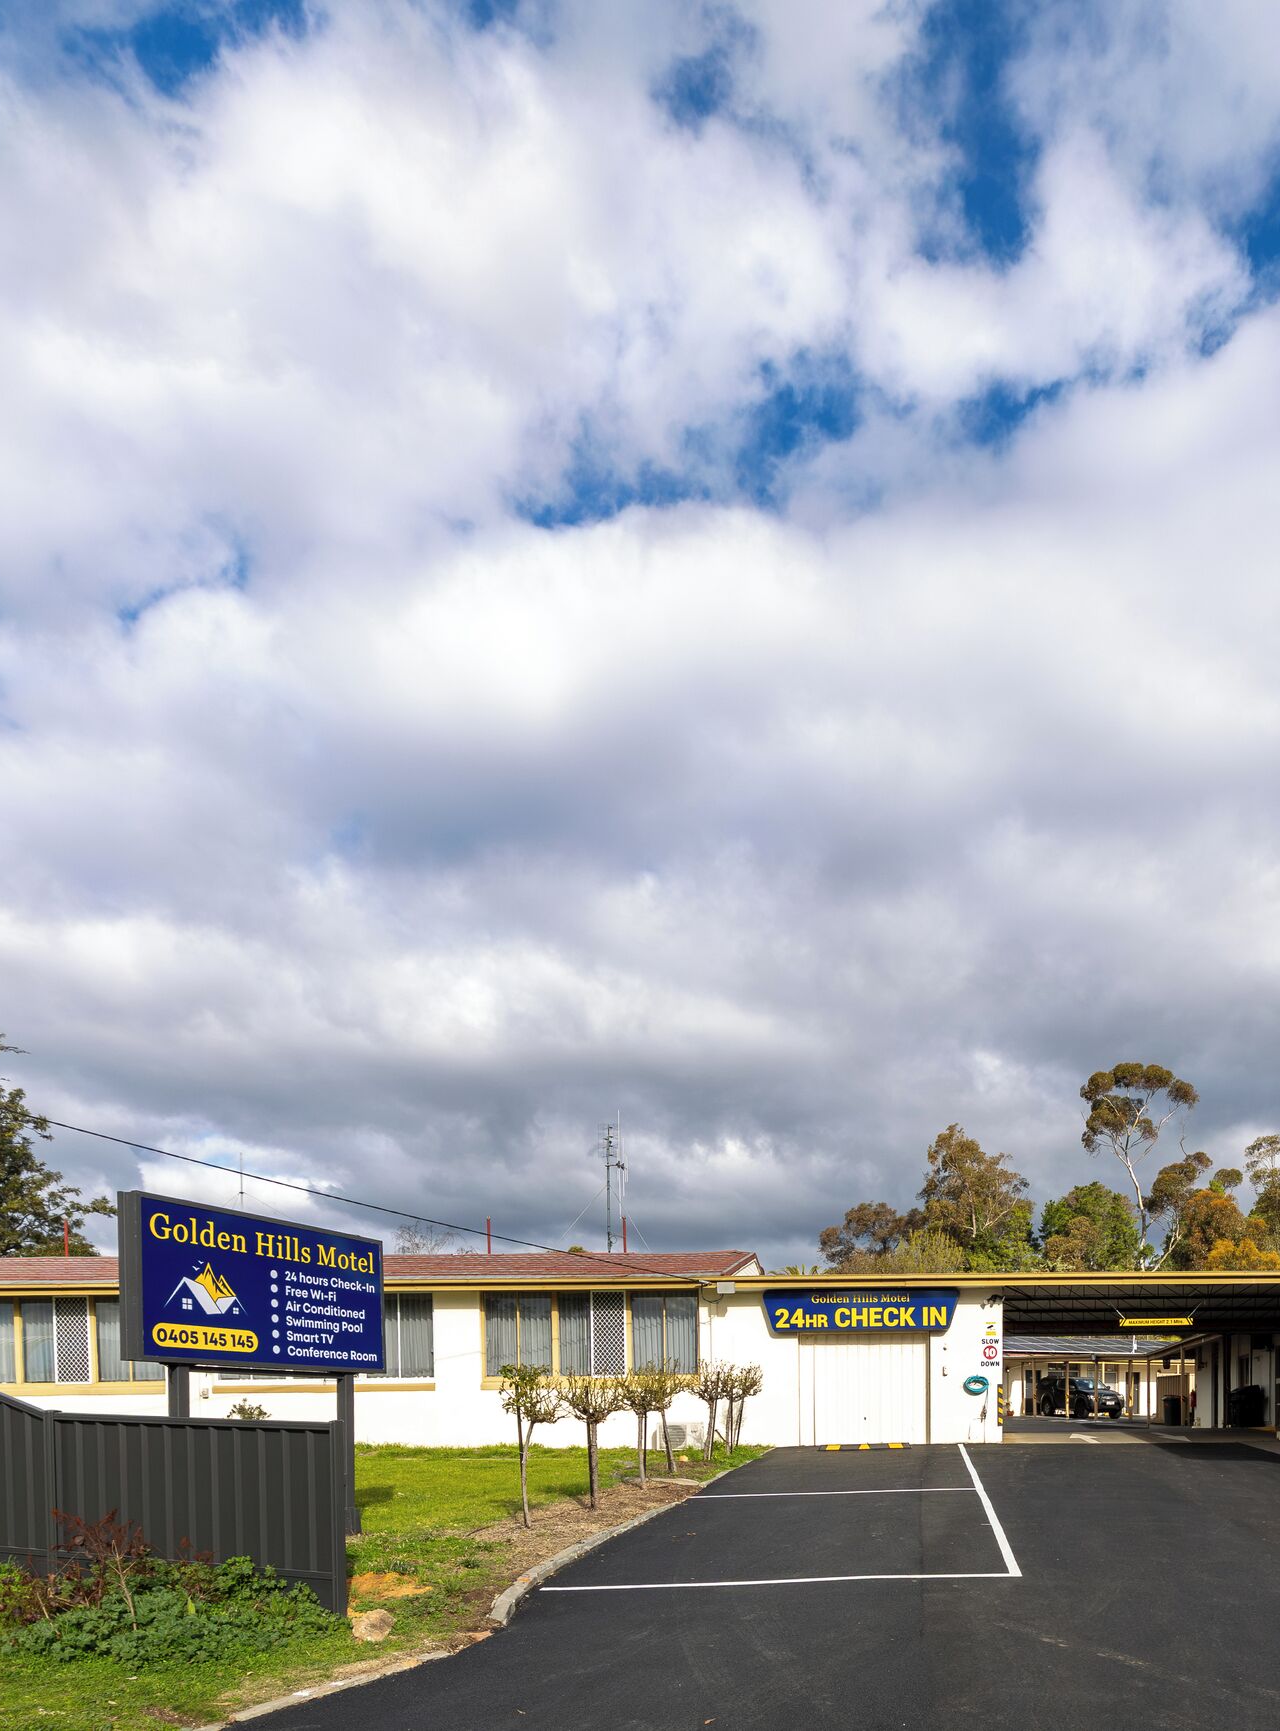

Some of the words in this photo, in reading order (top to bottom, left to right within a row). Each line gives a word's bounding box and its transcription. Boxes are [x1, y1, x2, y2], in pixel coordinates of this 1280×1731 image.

[149, 1212, 247, 1254] Golden
[255, 1231, 311, 1264] Hills
[317, 1244, 375, 1274] Motel
[284, 1270, 297, 1282] 24
[299, 1272, 329, 1287] hours
[330, 1277, 376, 1293] Check-In
[285, 1285, 308, 1298] Free
[310, 1288, 337, 1302] Wi-Fi
[811, 1294, 850, 1304] Golden
[853, 1294, 879, 1303] Hills
[881, 1294, 911, 1303] Motel
[285, 1300, 302, 1312] Air
[302, 1302, 366, 1319] Conditioned
[774, 1308, 829, 1329] 24HR
[834, 1306, 916, 1328] CHECK
[922, 1306, 947, 1327] IN
[285, 1315, 340, 1333] Swimming
[341, 1321, 363, 1333] Pool
[156, 1328, 199, 1345] 0405
[202, 1331, 227, 1347] 145
[230, 1334, 254, 1349] 145
[286, 1330, 320, 1343] Smart
[320, 1333, 334, 1345] TV
[287, 1345, 349, 1360] Conference
[350, 1350, 378, 1362] Room
[985, 1348, 996, 1357] 10
